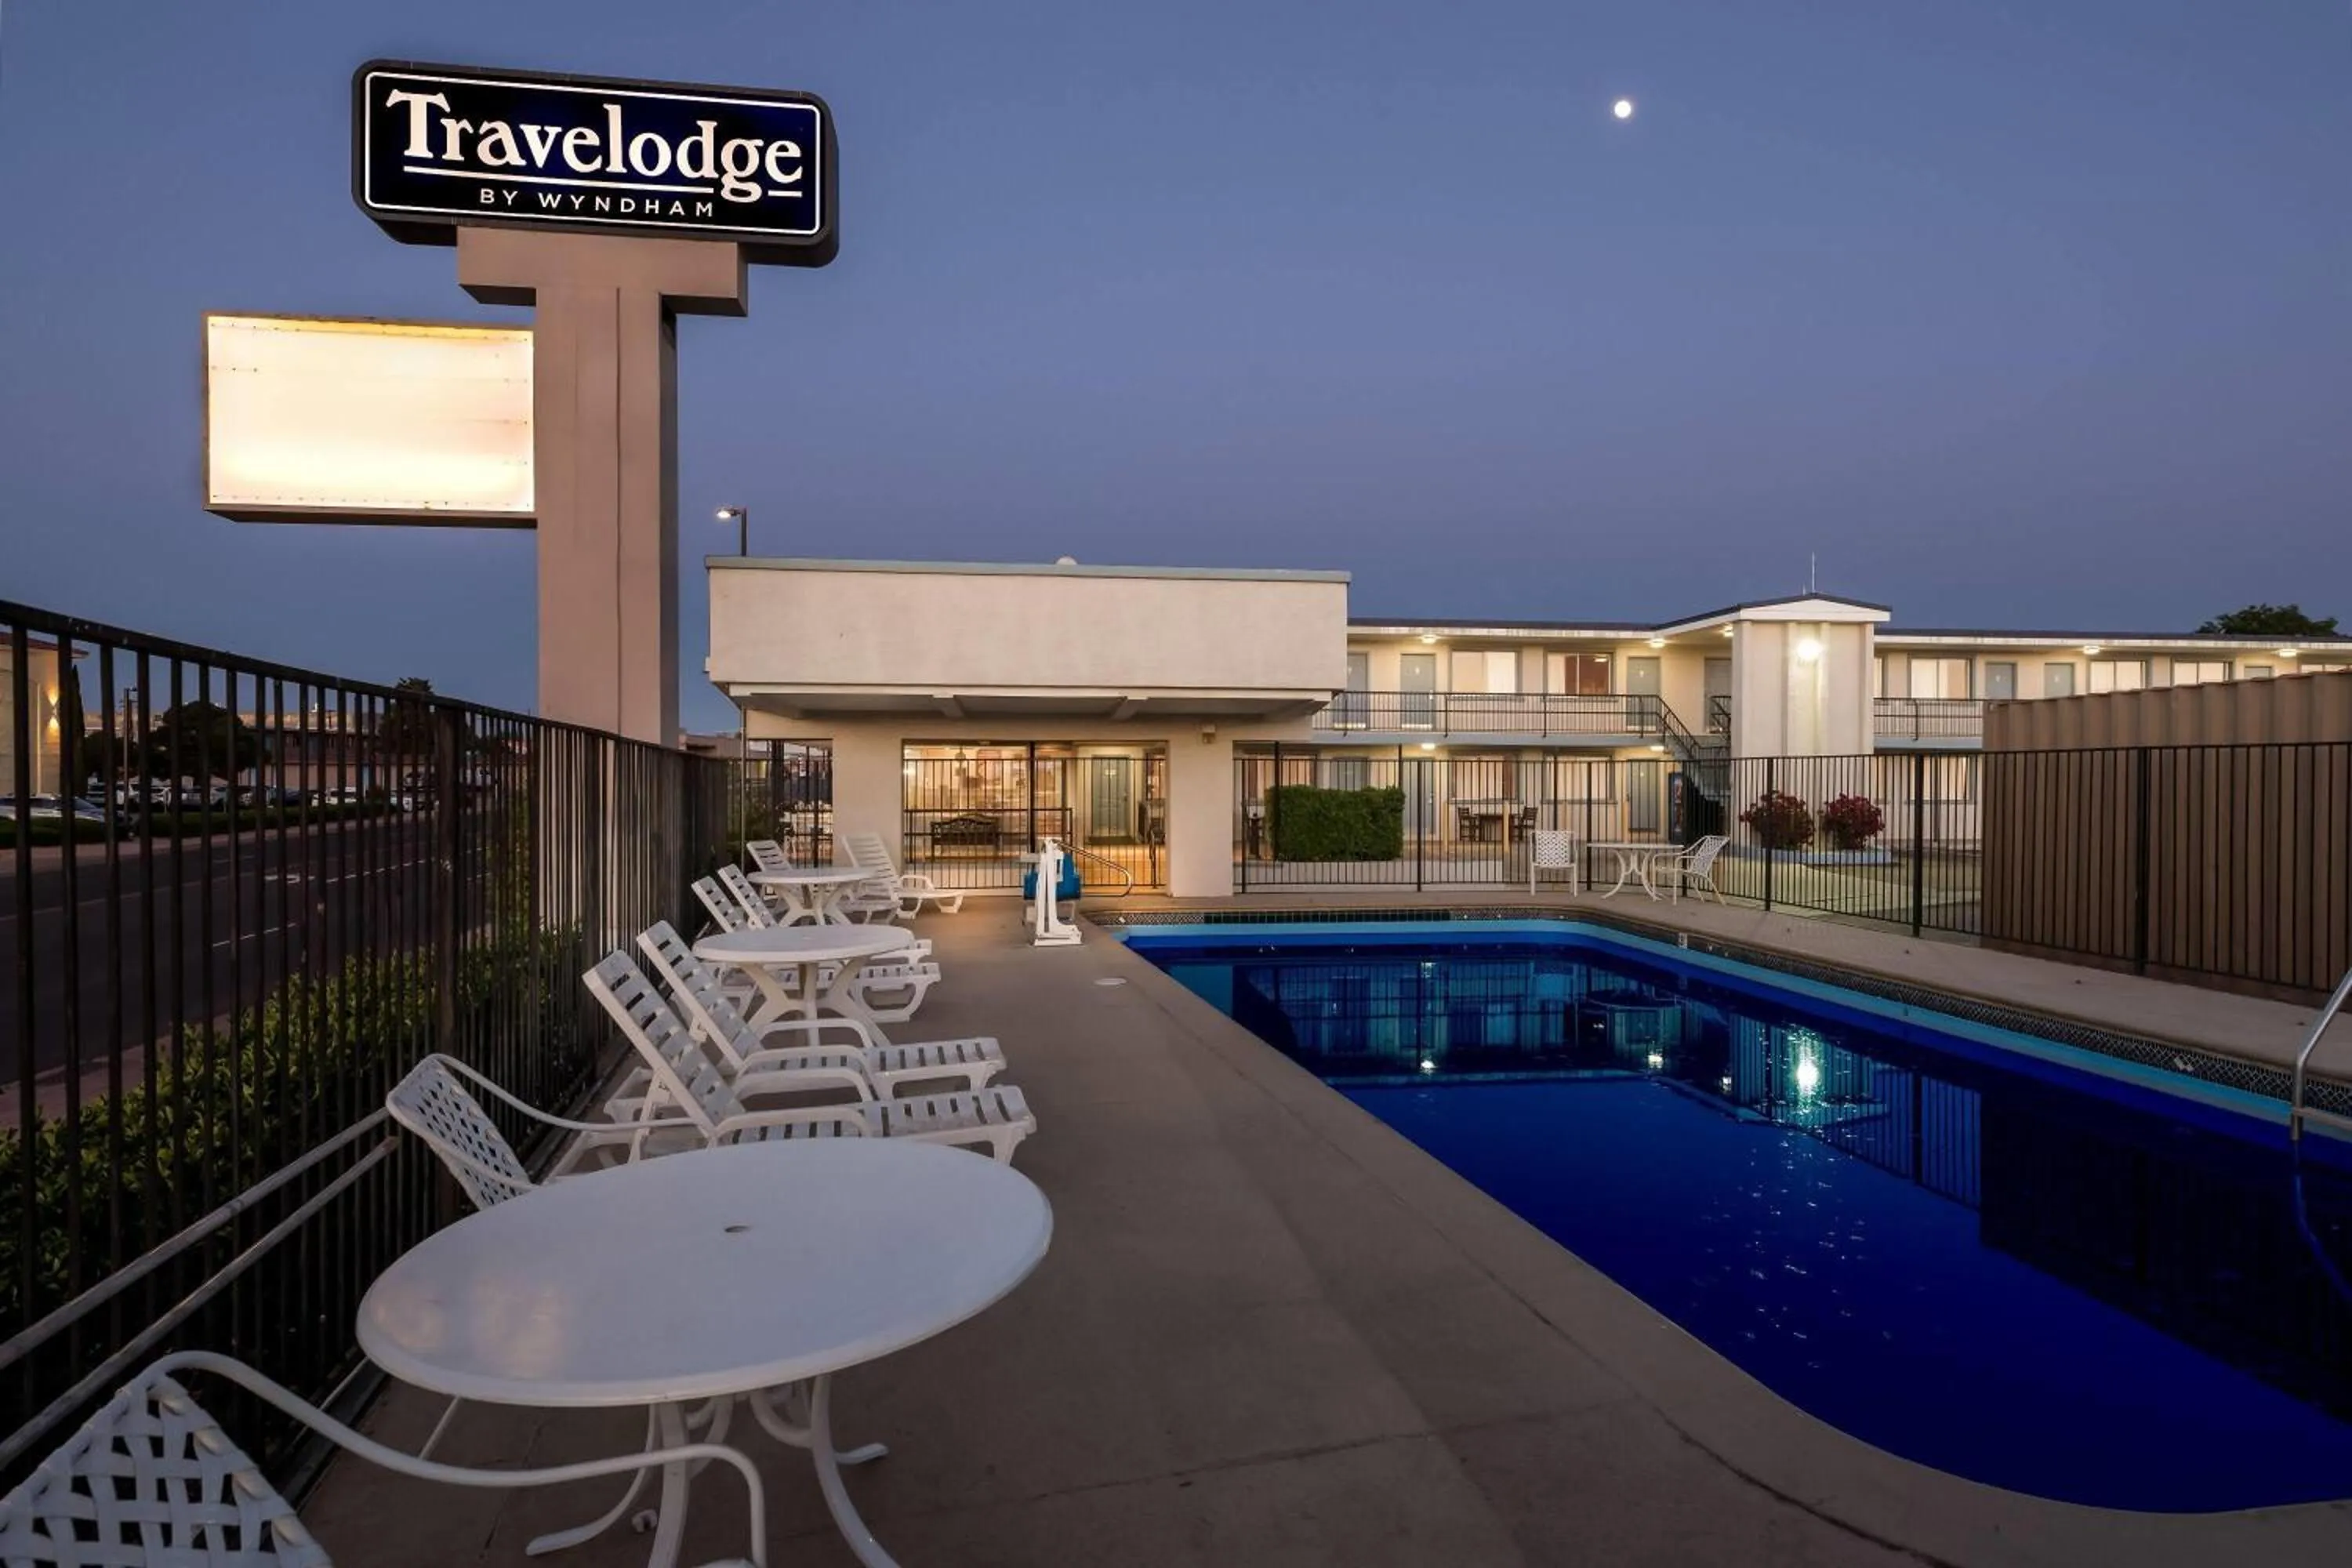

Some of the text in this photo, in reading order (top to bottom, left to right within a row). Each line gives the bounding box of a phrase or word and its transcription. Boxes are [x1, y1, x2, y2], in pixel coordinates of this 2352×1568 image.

[385, 89, 803, 203] Travelodge
[480, 188, 713, 217] BY WYNDHAM
